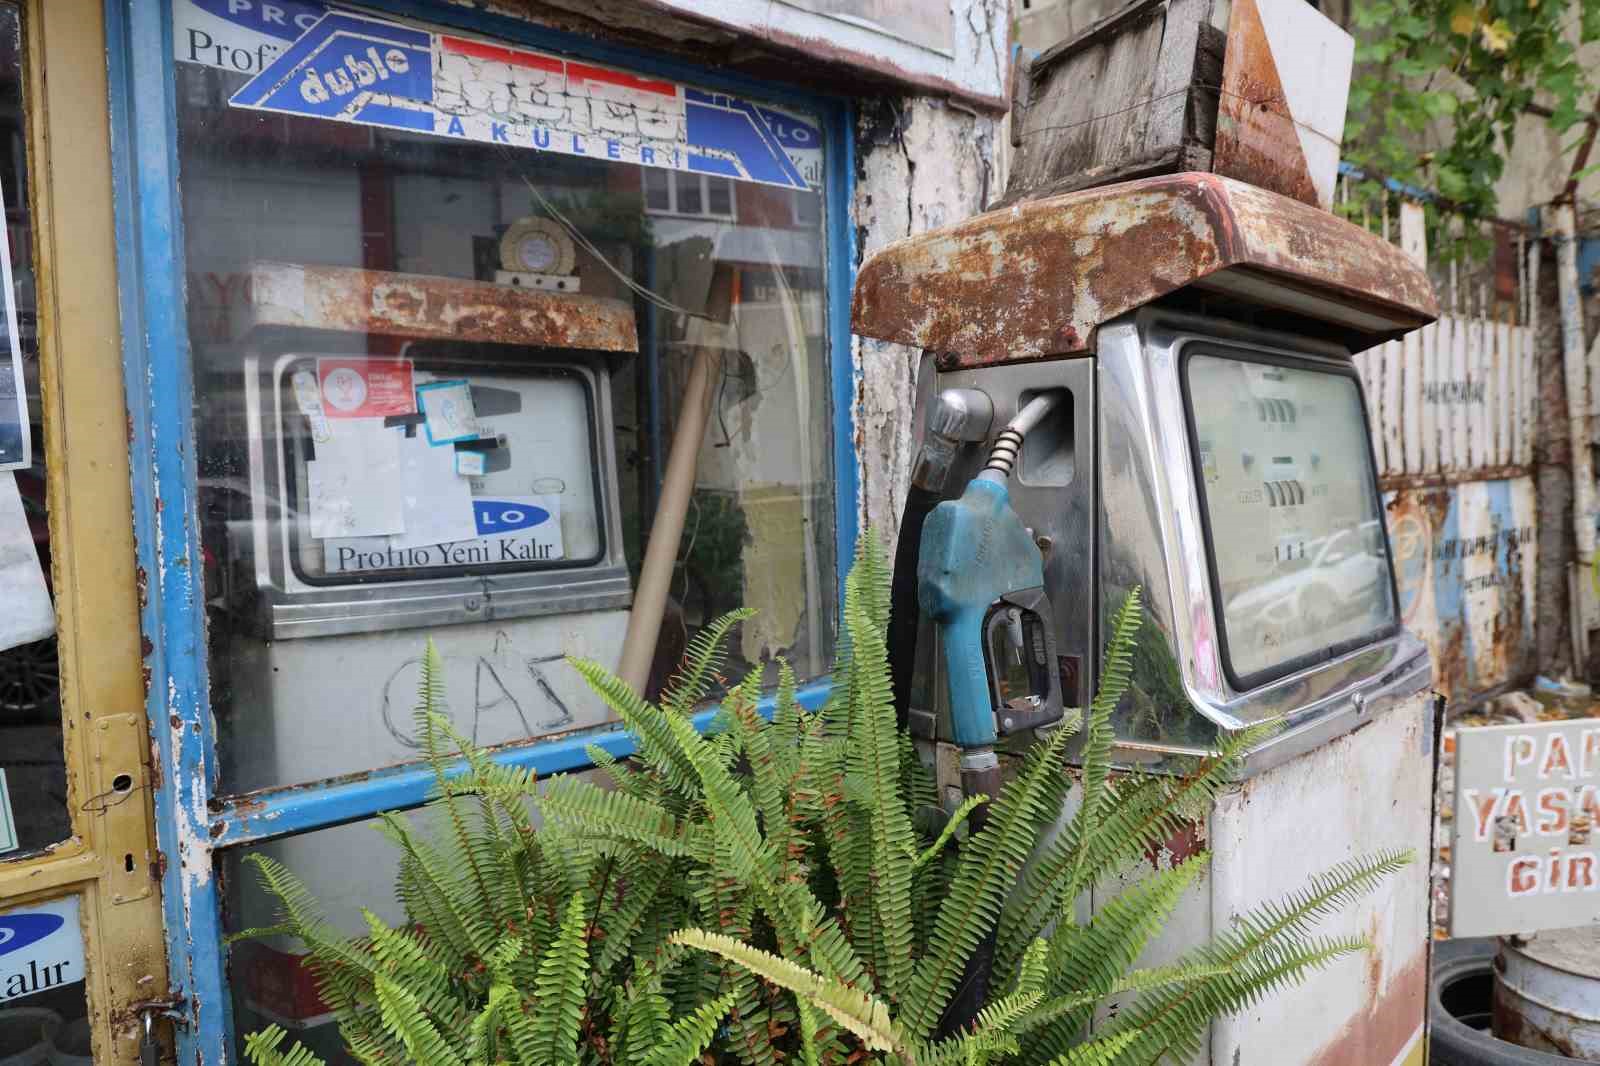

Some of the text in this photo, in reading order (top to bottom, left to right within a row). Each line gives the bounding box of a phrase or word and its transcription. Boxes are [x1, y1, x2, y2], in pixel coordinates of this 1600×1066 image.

[300, 46, 409, 104] duble
[483, 510, 525, 525] LO
[437, 539, 490, 564] Yeni
[500, 537, 553, 561] Kalır
[0, 959, 70, 999] alır
